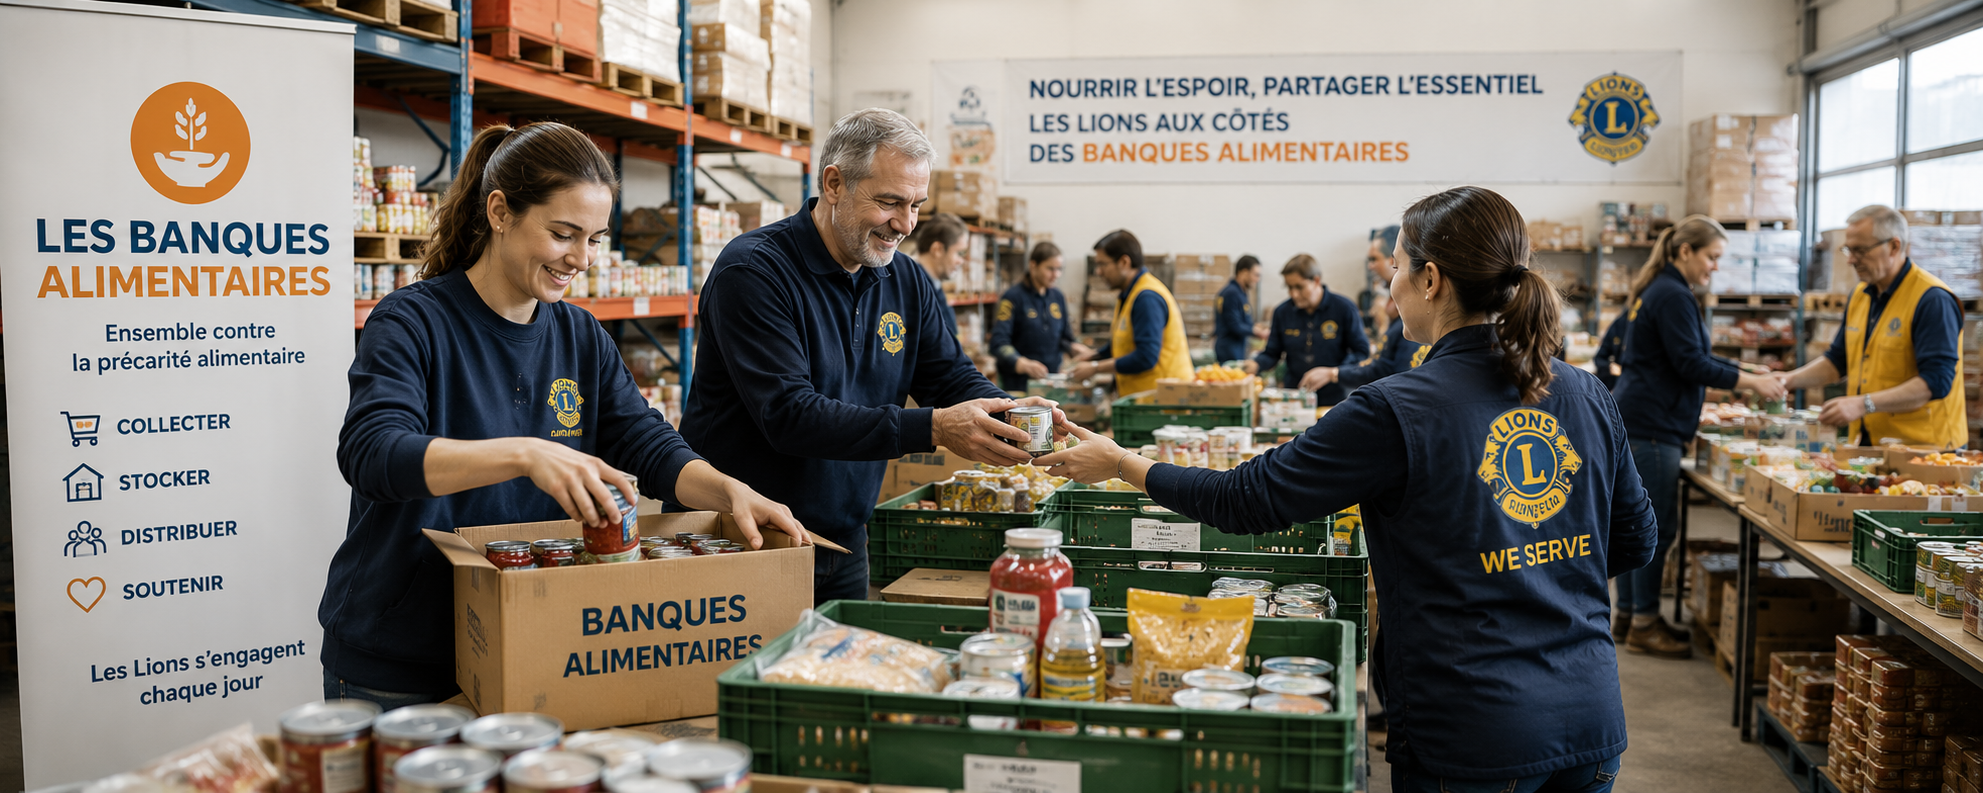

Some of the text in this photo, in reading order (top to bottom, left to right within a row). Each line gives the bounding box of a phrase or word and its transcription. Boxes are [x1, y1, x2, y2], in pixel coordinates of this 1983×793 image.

[1031, 75, 1543, 98] NOURRIR L'ESPOIR, PARTAGER L'ESSENTIEL
[1590, 78, 1639, 96] LIONS
[1030, 114, 1069, 132] LES
[1079, 114, 1147, 132] LIONS
[1155, 114, 1203, 131] AUX
[1604, 101, 1627, 134] L
[1030, 142, 1408, 163] DES BANQUES ALIMENTAIRES
[37, 217, 330, 258] LES BANQUES
[37, 266, 330, 298] ALIMENTAIRES
[106, 323, 275, 342] Ensemble contre
[72, 347, 306, 375] la précarité alimentaire
[561, 393, 574, 411] L
[117, 414, 230, 434] COLLECTER
[1495, 412, 1554, 438] LIONS
[1516, 443, 1547, 486] L
[120, 470, 210, 490] STOCKER
[122, 521, 237, 545] DISTRIBUER
[1480, 534, 1590, 574] WE SERVE
[123, 576, 223, 600] SOUTENIR
[582, 594, 747, 636] BANQUES
[91, 639, 306, 683] Les Lions s'engagent
[563, 634, 762, 678] ALIMENTAIRES
[139, 675, 264, 706] chaque jour
